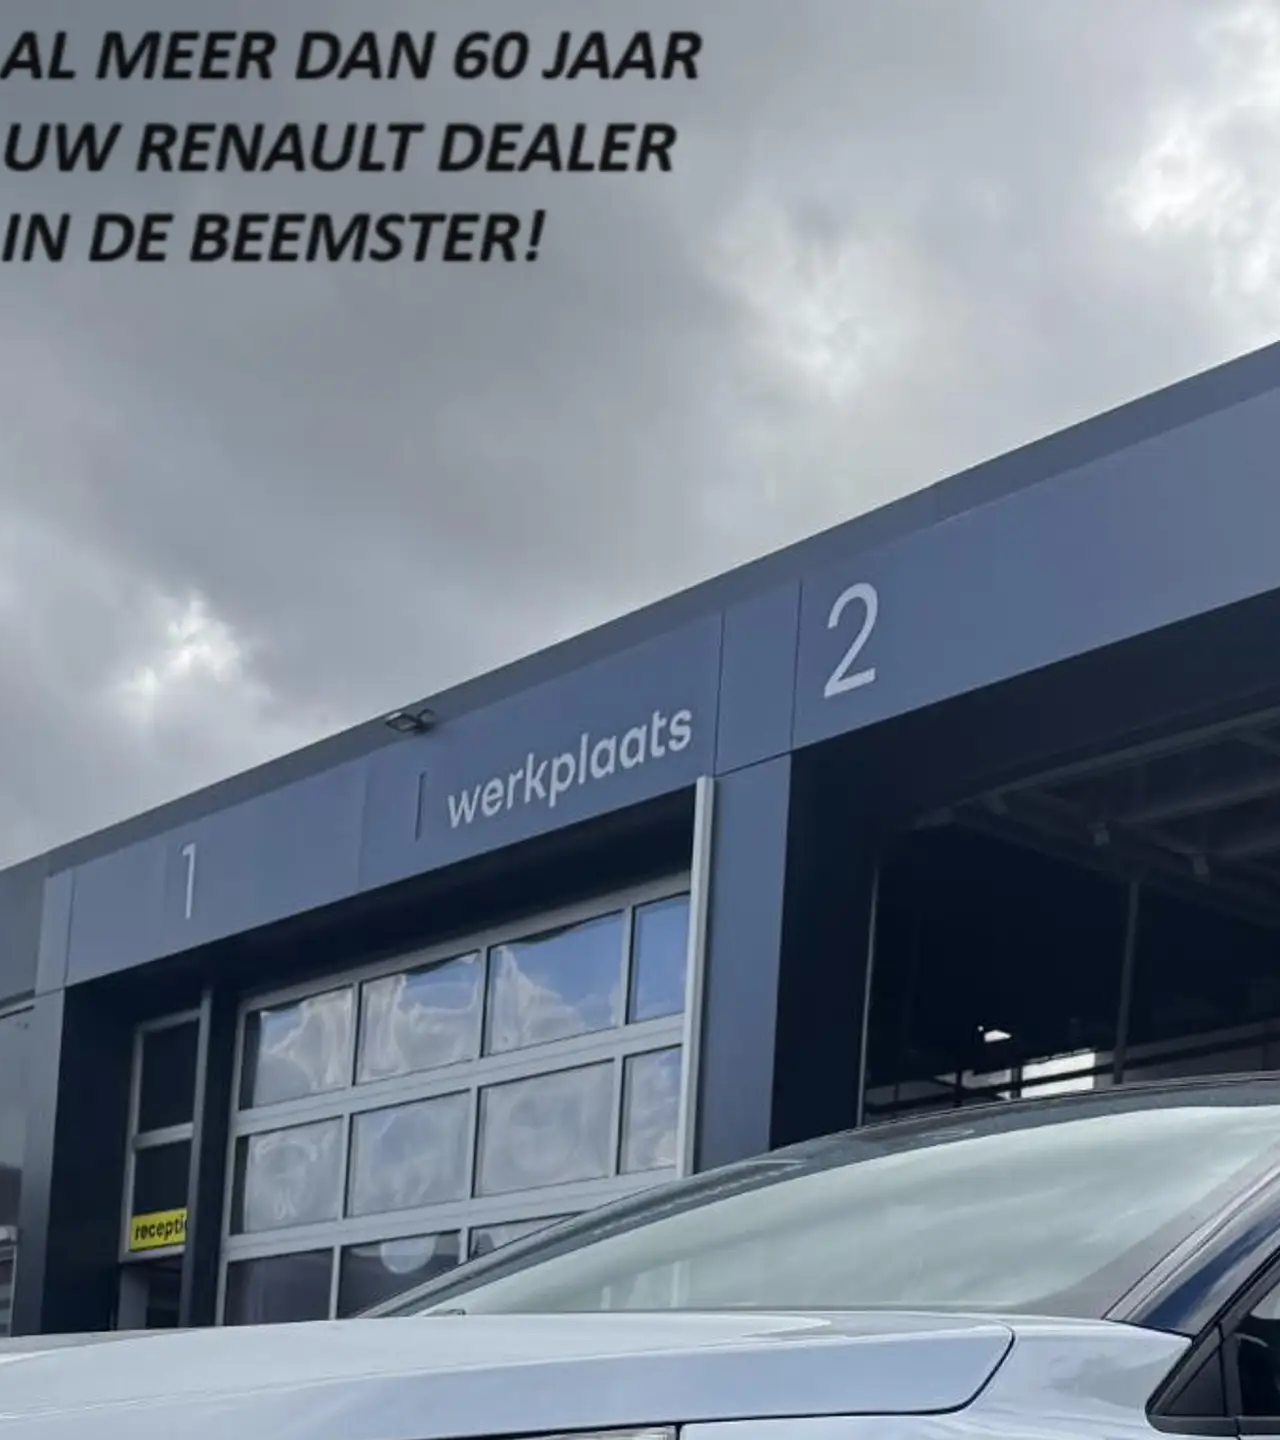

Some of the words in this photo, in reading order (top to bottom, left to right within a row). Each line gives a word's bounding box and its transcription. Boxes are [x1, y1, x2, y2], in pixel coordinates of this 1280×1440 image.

[823, 582, 879, 699] 2
[447, 708, 693, 829] werkplaats
[181, 843, 197, 919] 1
